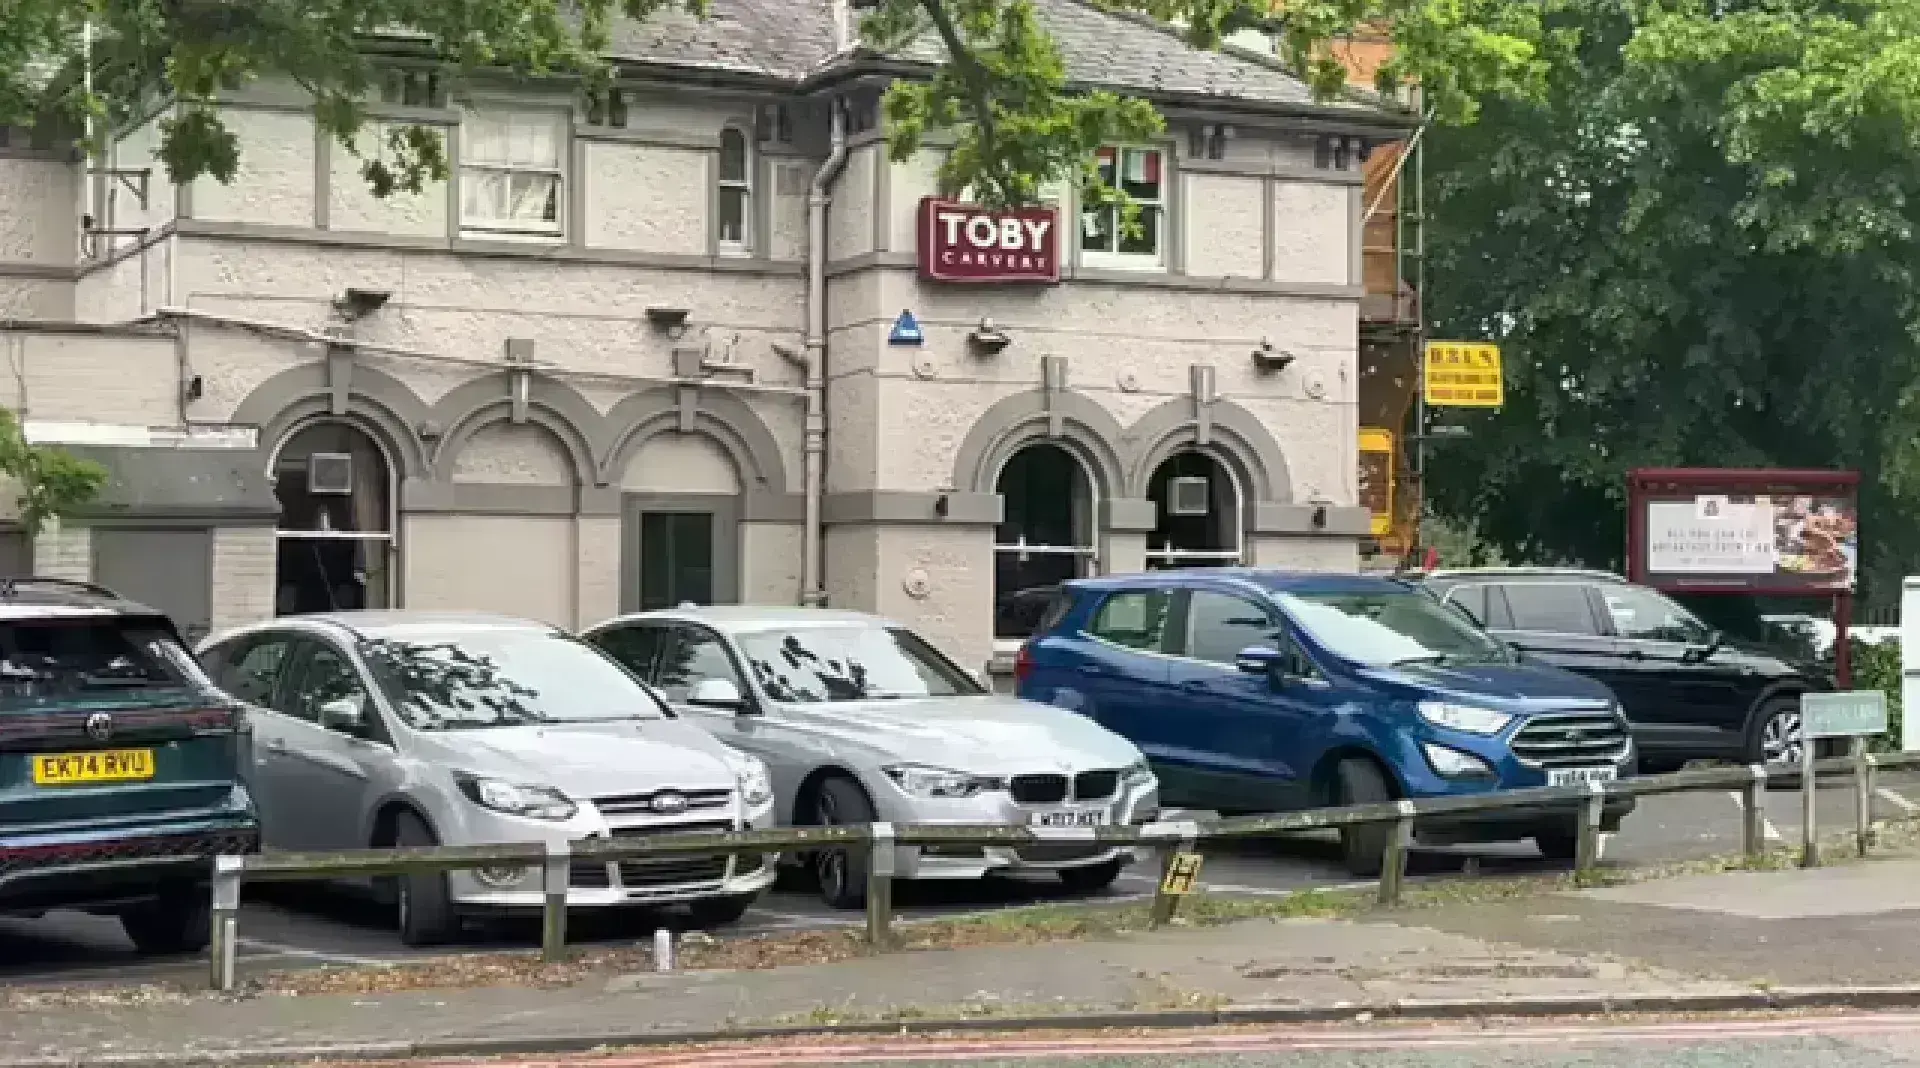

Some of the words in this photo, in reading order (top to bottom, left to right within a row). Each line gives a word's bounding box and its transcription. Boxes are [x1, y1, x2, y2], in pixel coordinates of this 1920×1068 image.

[939, 212, 1050, 251] TOBY
[42, 755, 99, 778] EK74
[104, 751, 145, 775] RVU
